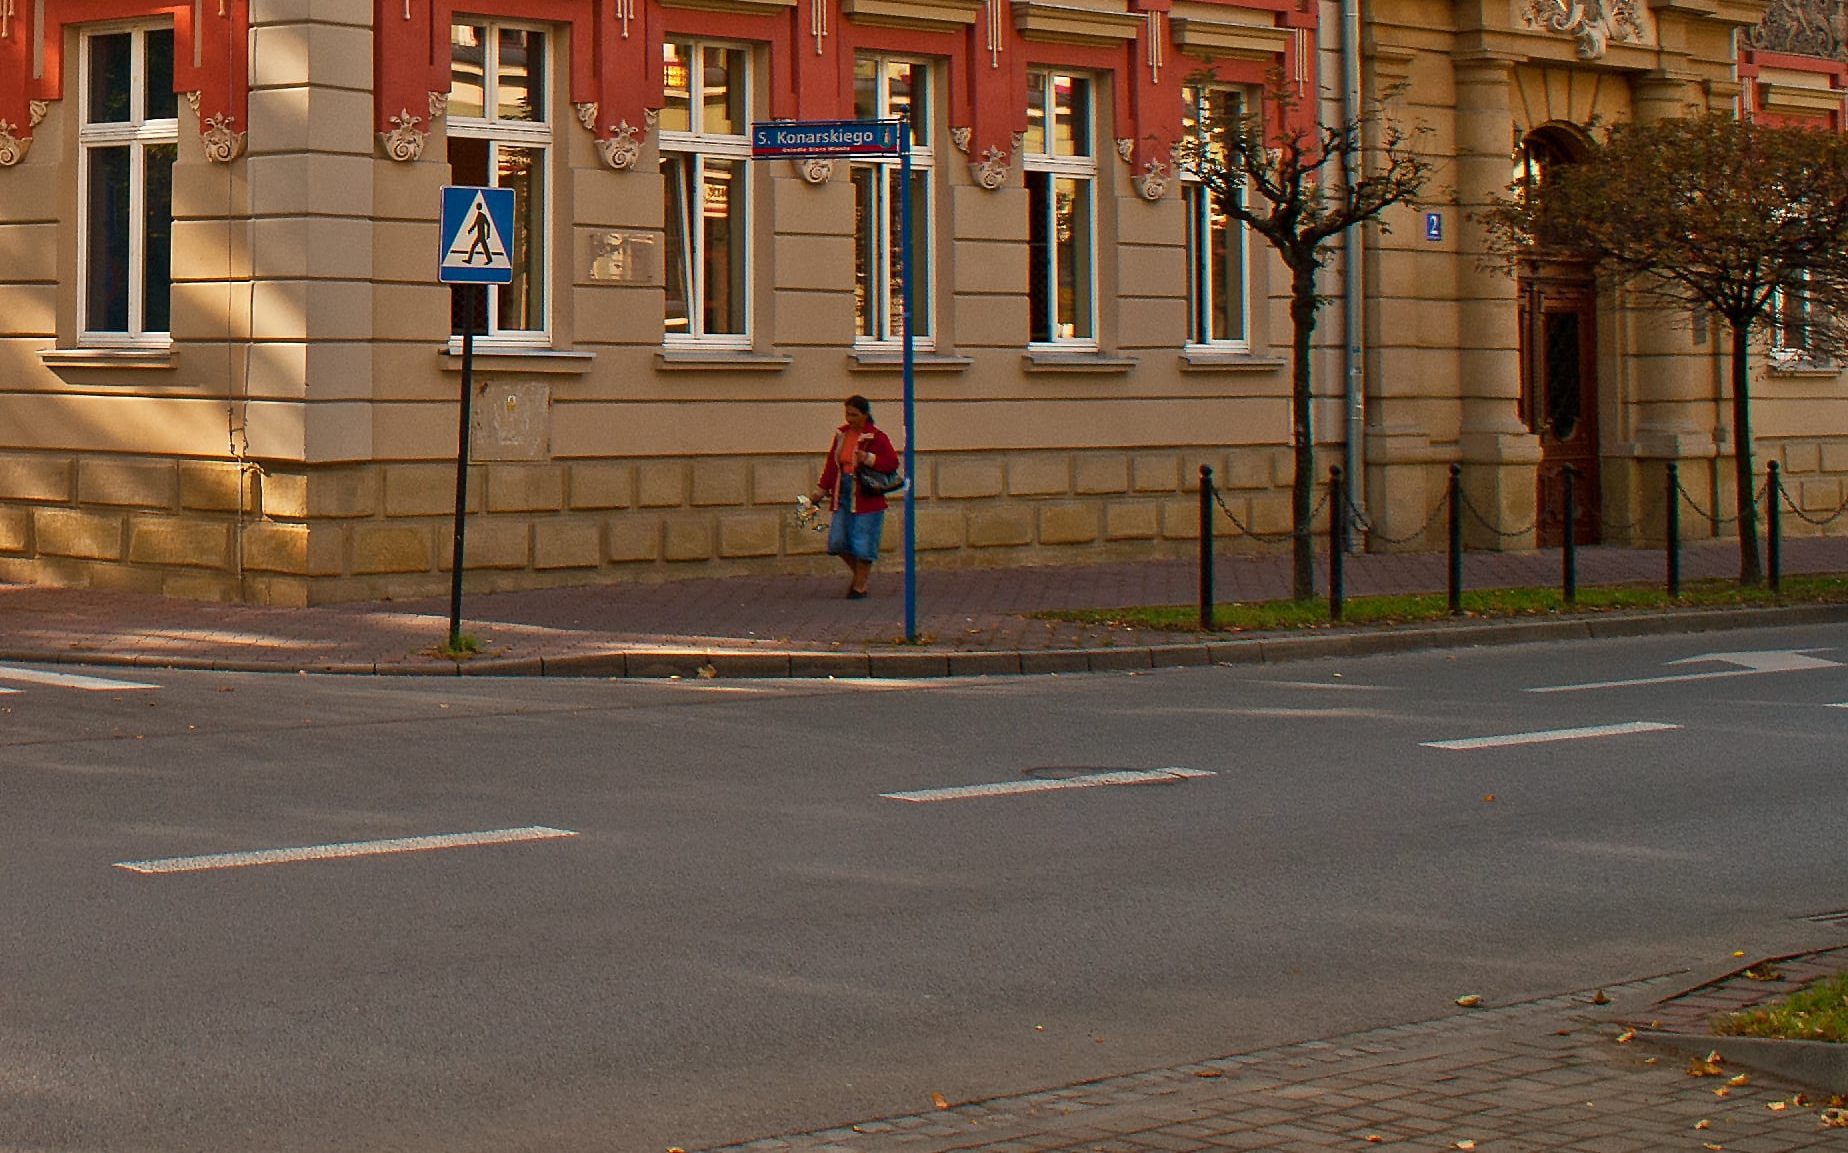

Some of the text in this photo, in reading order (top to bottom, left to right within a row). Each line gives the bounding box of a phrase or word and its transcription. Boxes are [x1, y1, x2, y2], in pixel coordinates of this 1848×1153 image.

[758, 129, 873, 145] S. Konarskiego
[1429, 215, 1440, 235] 2
